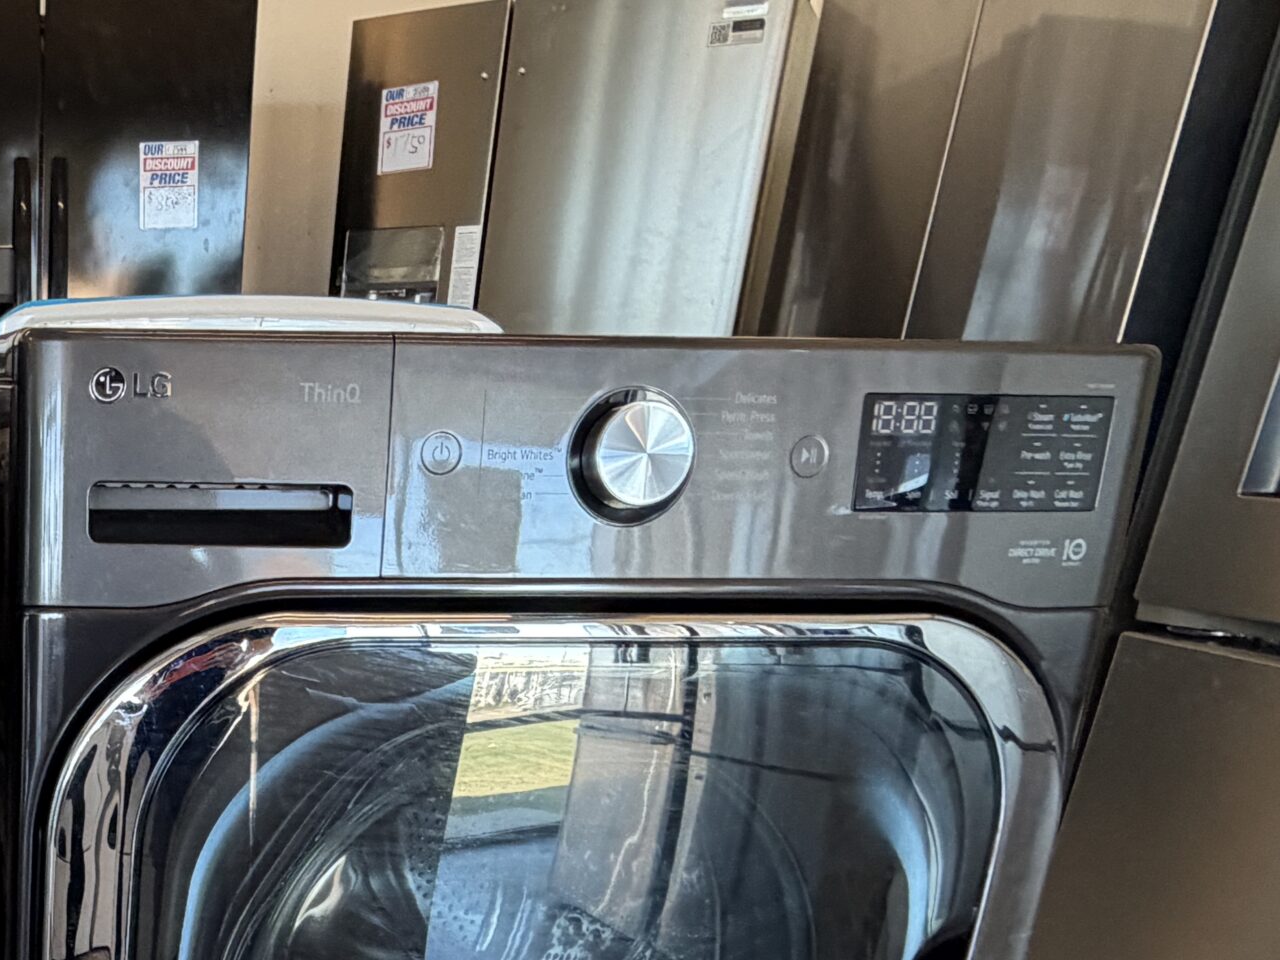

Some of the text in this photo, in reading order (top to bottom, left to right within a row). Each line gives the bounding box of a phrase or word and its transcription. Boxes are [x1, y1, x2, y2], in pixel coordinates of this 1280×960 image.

[385, 88, 405, 102] OUR
[387, 98, 433, 115] DISCOUNT
[389, 112, 427, 130] PRICE
[143, 144, 164, 156] OUR
[145, 157, 194, 171] DISCOUNT
[149, 172, 189, 186] PRICE
[132, 371, 172, 399] LG
[300, 382, 361, 404] ThinQ
[487, 448, 517, 463] Bright
